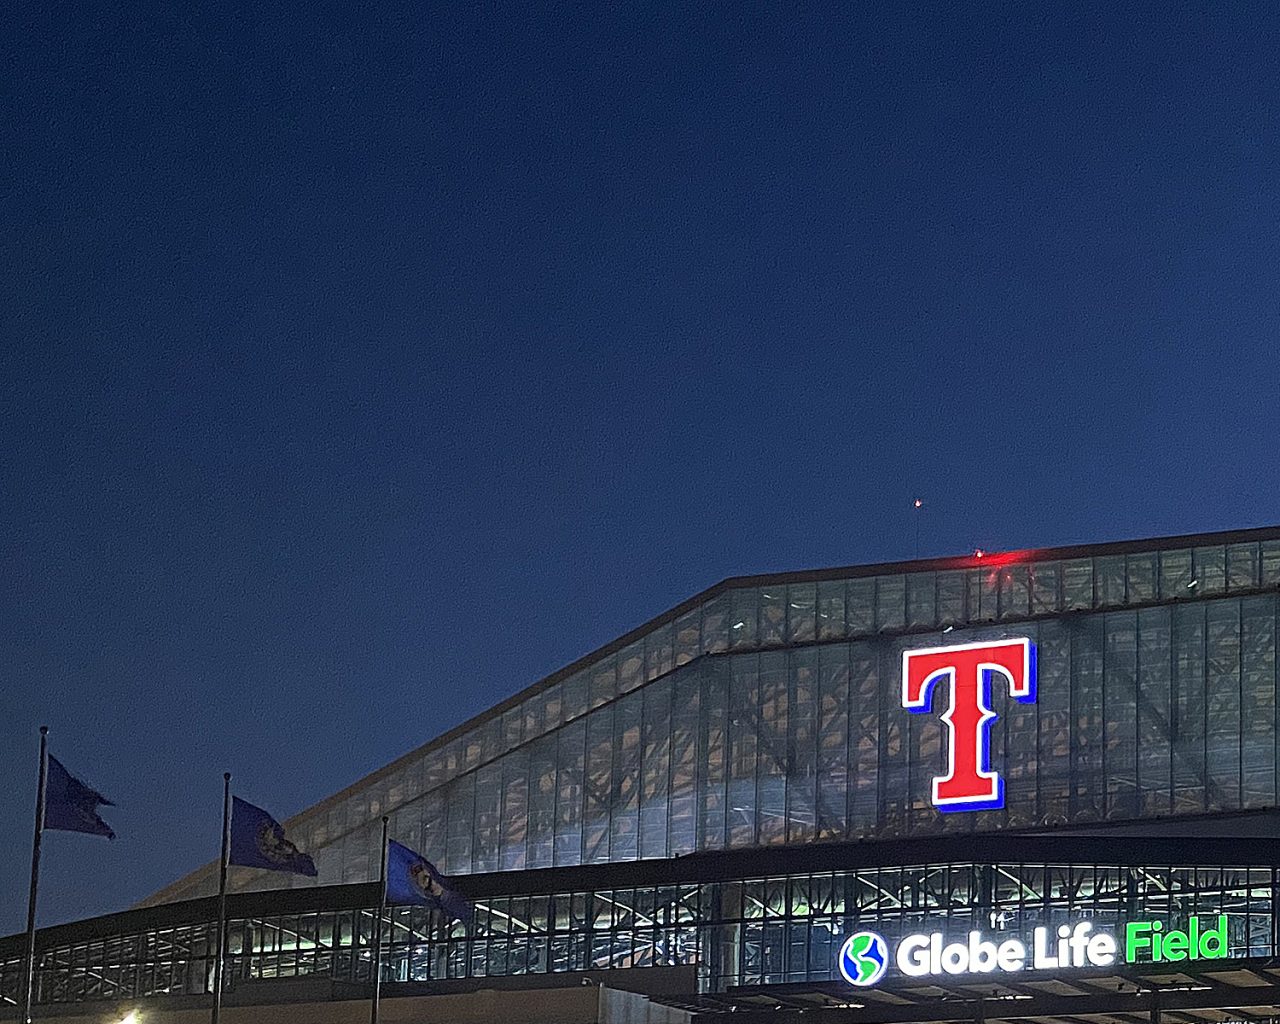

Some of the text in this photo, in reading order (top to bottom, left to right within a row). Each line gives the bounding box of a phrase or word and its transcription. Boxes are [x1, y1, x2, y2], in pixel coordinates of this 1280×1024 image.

[903, 637, 1036, 812] T
[896, 915, 1228, 977] Globe Life Field
